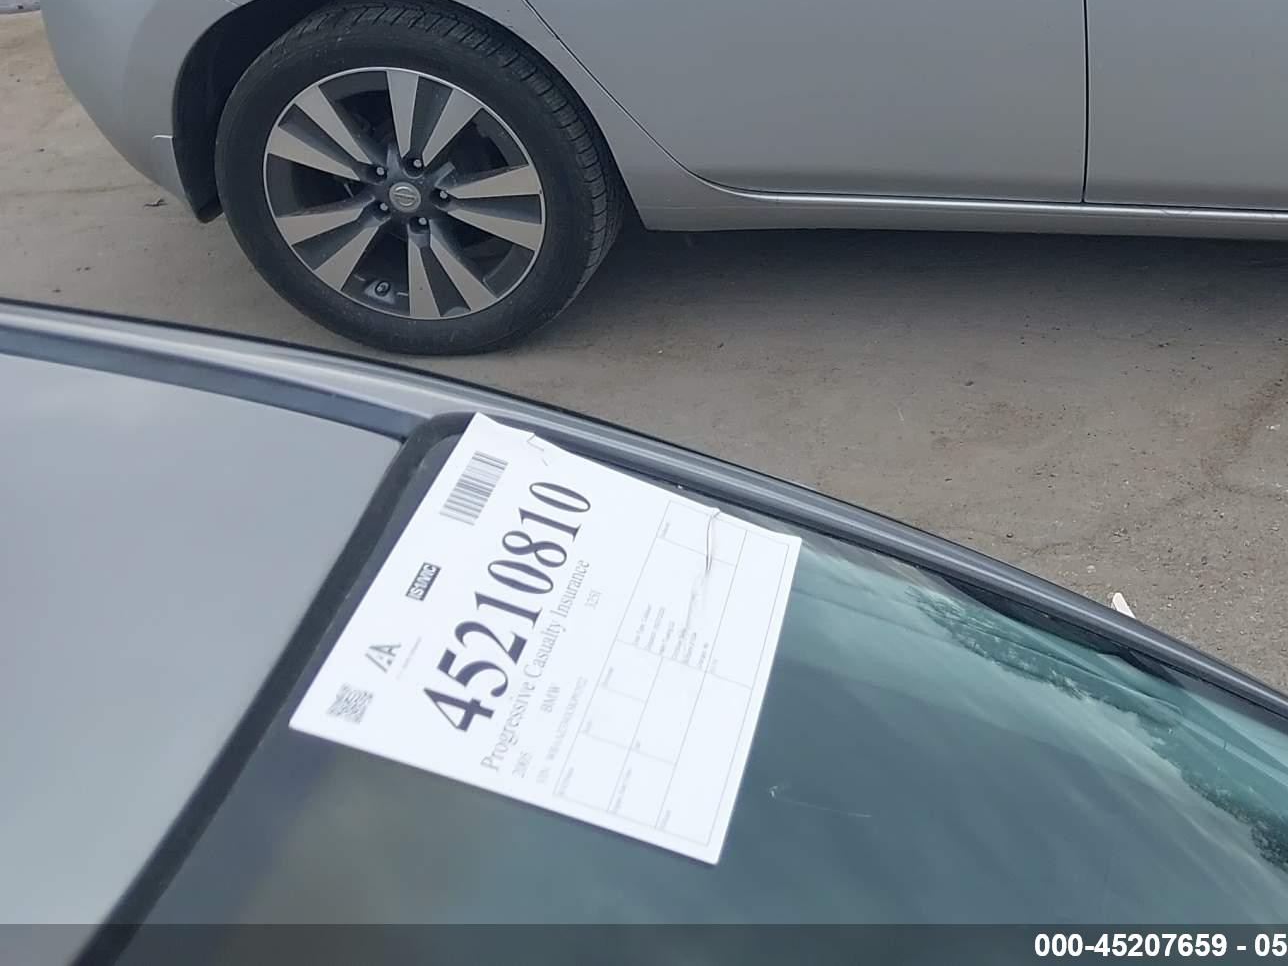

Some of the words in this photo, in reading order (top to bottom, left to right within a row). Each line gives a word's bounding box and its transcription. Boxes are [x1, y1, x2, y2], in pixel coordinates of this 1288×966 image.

[423, 482, 591, 732] 45210810
[480, 681, 536, 771] Progressive
[523, 620, 566, 679] Casualty
[550, 560, 590, 618] Insurance
[540, 684, 560, 714] BMW
